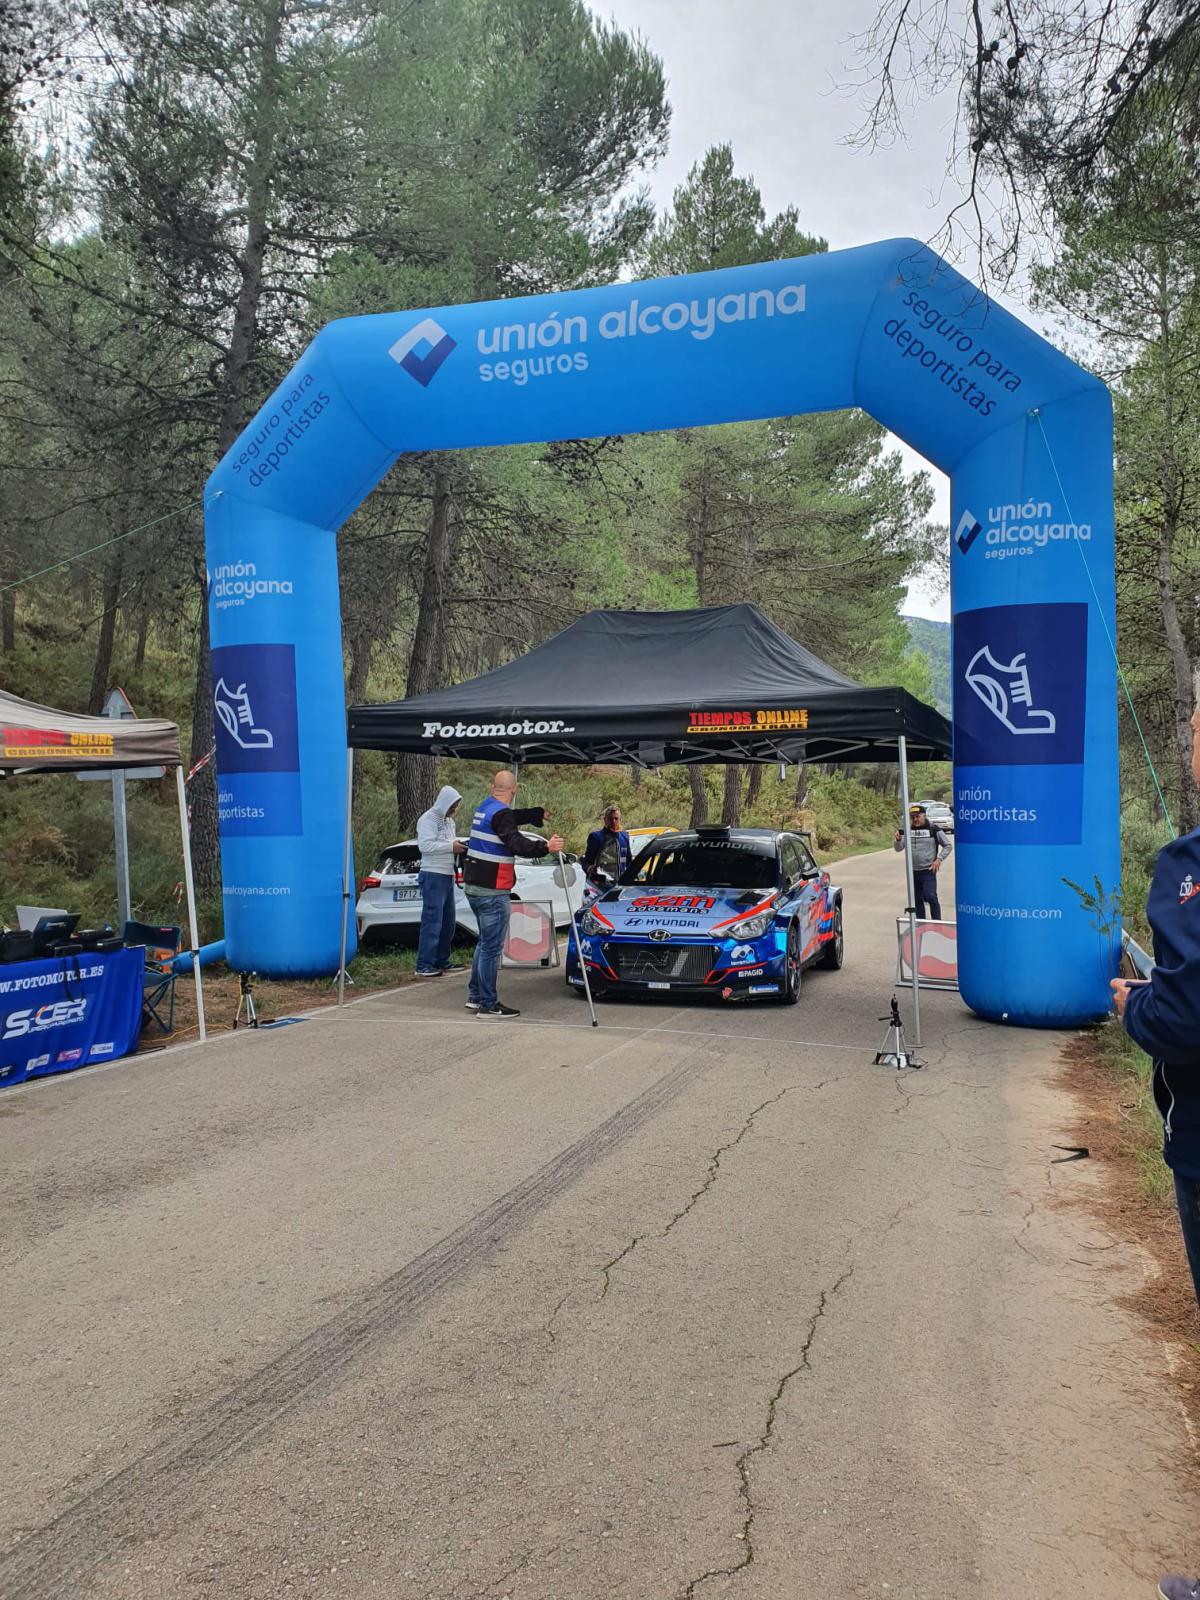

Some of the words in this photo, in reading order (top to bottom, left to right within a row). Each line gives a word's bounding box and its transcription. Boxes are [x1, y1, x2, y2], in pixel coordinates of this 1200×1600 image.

[477, 311, 587, 355] unión
[598, 284, 806, 341] alcoyana
[902, 290, 973, 353] seguro
[973, 347, 1023, 393] para
[478, 351, 590, 386] seguros
[884, 318, 998, 417] deportistas
[232, 410, 281, 474] seguro
[281, 372, 315, 421] para
[248, 391, 331, 489] deportistas
[988, 497, 1052, 523] unión
[985, 520, 1092, 547] alcoyana
[984, 546, 1034, 561] seguros
[214, 559, 257, 580] unión
[214, 579, 294, 599] alcoyana
[215, 598, 245, 610] seguros
[689, 711, 752, 725] TIEMPOS
[756, 709, 809, 724] ONLINE
[958, 786, 992, 801] unión
[958, 806, 1037, 824] deportistas
[689, 841, 759, 851] HYUNDAI
[646, 918, 700, 928] HYUNDAI
[744, 968, 764, 977] PAGID
